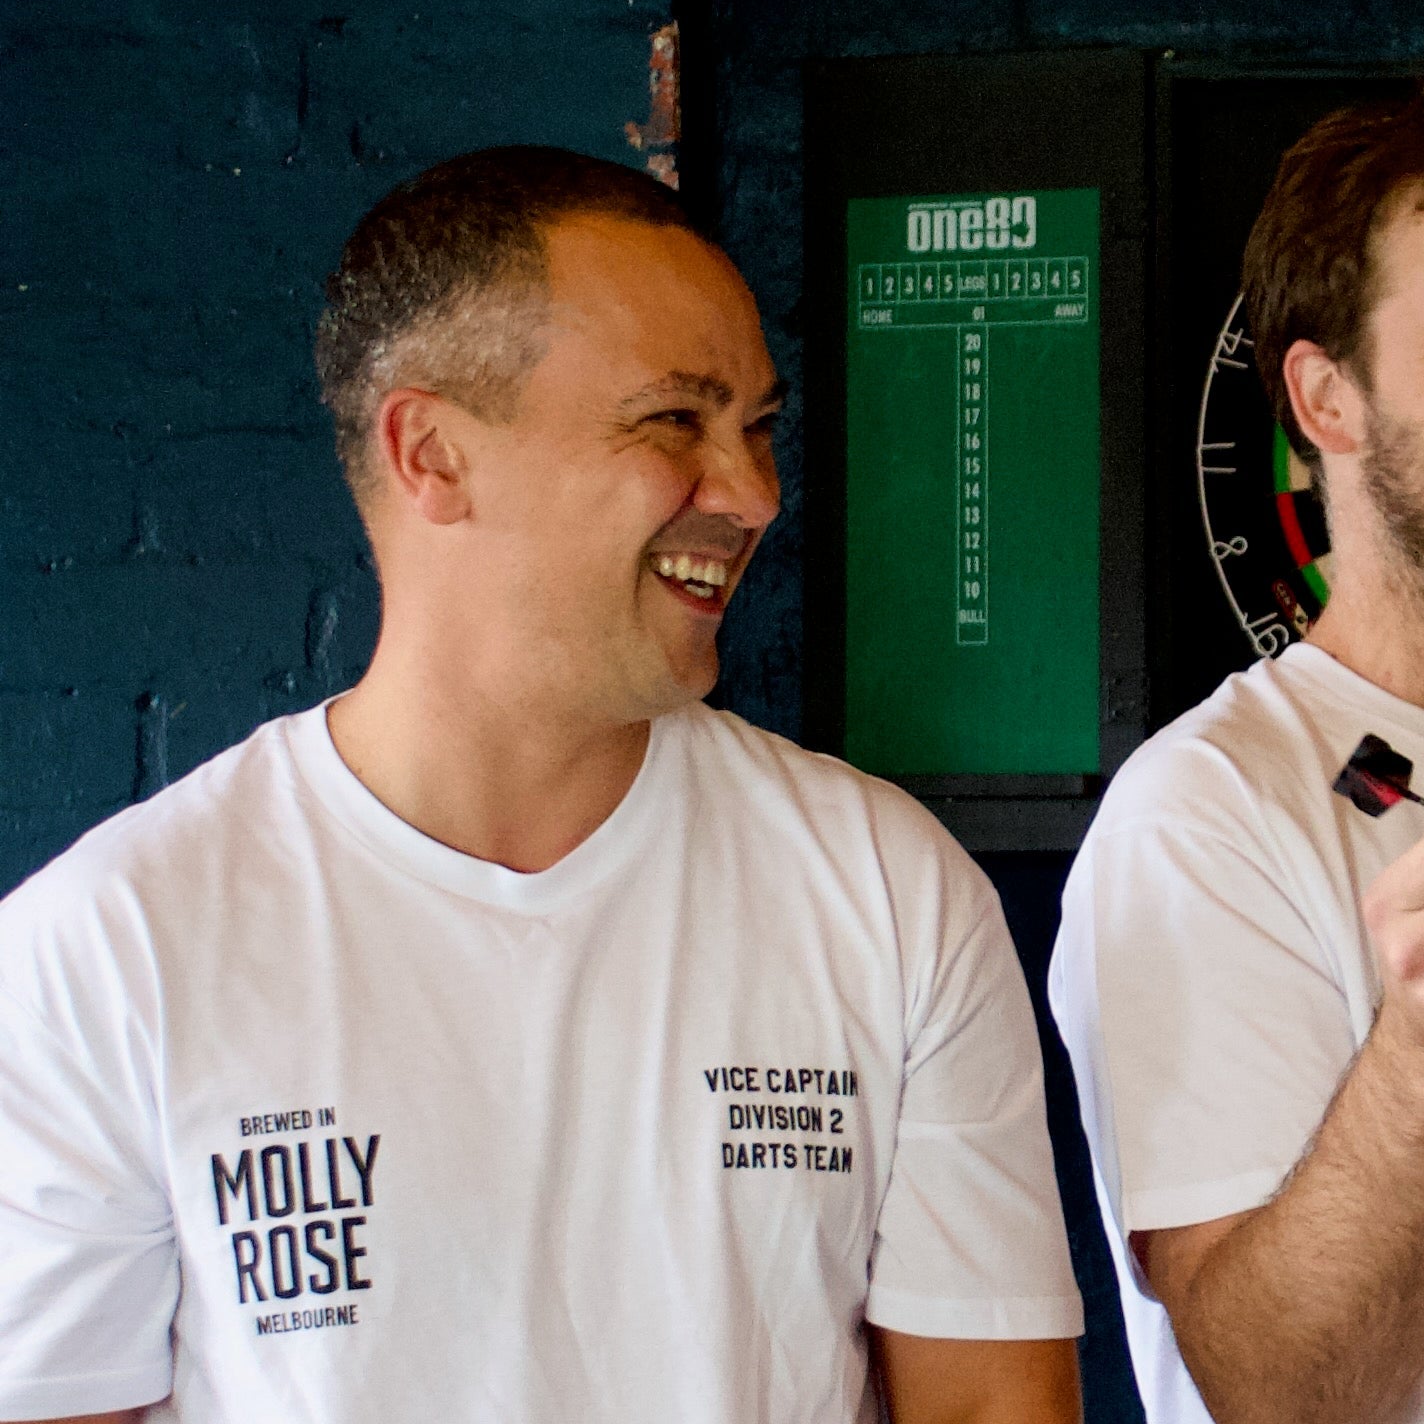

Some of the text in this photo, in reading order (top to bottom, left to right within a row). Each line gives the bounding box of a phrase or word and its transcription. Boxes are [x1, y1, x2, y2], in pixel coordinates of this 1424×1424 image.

[866, 277, 874, 296] 1
[885, 275, 896, 295] 2
[904, 275, 914, 295] 3
[923, 274, 933, 294] 4
[944, 274, 954, 294] 5
[992, 272, 1000, 291] 1
[1011, 271, 1022, 291] 2
[1030, 270, 1041, 290] 3
[1050, 270, 1061, 289] 4
[1070, 268, 1081, 289] 5
[862, 309, 893, 324] HOME
[1053, 302, 1085, 318] AWAY
[964, 333, 982, 352] 20
[1212, 327, 1254, 374] 14
[964, 358, 981, 376] 19
[964, 382, 981, 401] 18
[964, 408, 980, 425] 17
[964, 432, 981, 451] 16
[964, 457, 981, 475] 15
[1197, 441, 1238, 475] 11
[964, 482, 980, 500] 14
[964, 506, 980, 525] 13
[964, 532, 981, 550] 12
[1212, 534, 1249, 562] 8
[964, 556, 980, 574] 11
[964, 580, 981, 600] 10
[958, 609, 986, 624] BULL
[1241, 610, 1290, 658] 16
[704, 1067, 859, 1097] VICE CAPTAIN
[240, 1106, 336, 1137] BREWED IN
[729, 1104, 845, 1134] DIVISION 2
[722, 1142, 854, 1174] DARTS TEAM
[211, 1133, 381, 1226] MOLLY
[232, 1216, 373, 1305] ROSE
[256, 1303, 359, 1336] MELBOURNE
